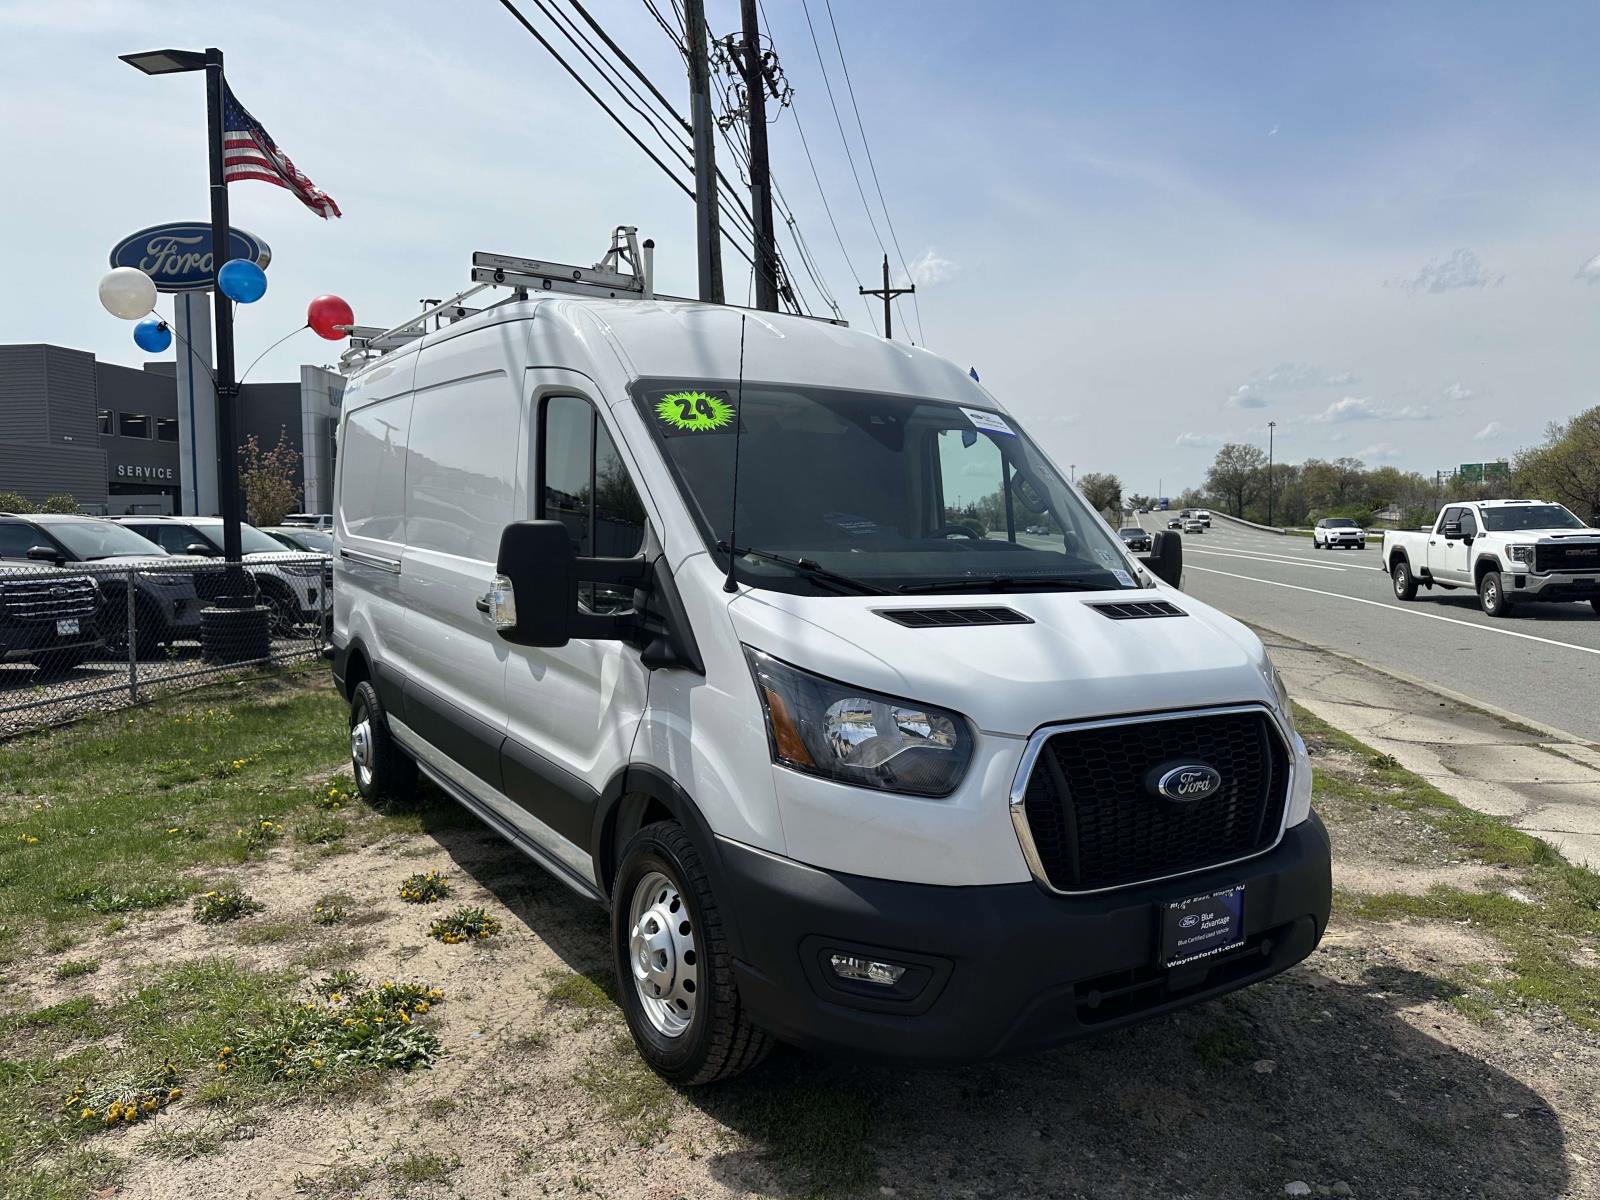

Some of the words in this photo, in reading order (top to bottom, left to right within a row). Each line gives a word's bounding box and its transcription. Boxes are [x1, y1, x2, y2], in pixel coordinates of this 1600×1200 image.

[674, 399, 715, 420] 24
[118, 464, 173, 479] SERVICE
[1178, 771, 1211, 794] Ford
[1201, 913, 1214, 922] Blue
[1201, 916, 1230, 930] Advantage
